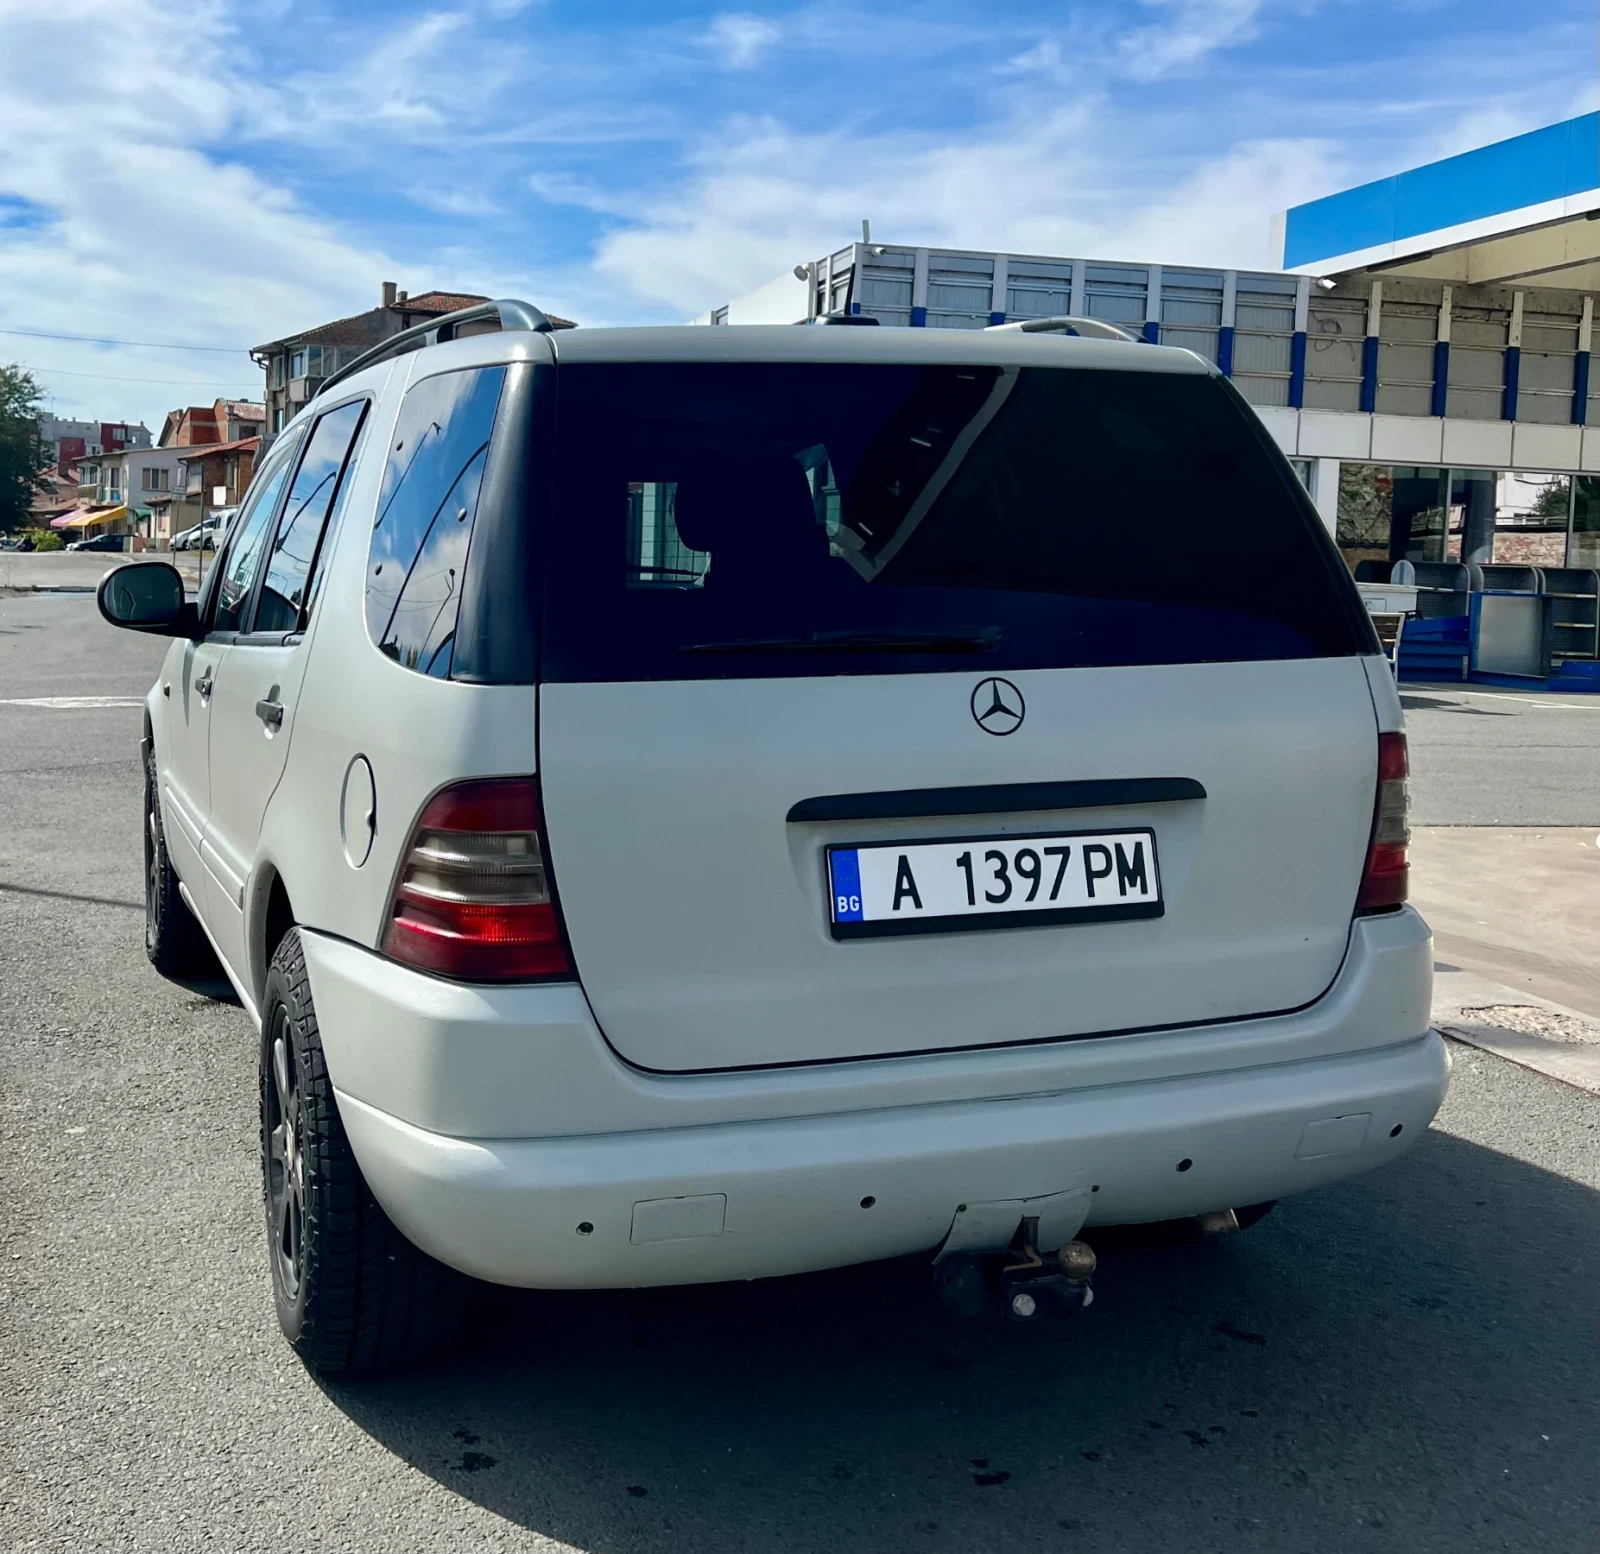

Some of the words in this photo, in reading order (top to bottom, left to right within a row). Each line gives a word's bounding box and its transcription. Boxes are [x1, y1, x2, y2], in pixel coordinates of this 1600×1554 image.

[892, 854, 923, 911] A
[956, 846, 1071, 905] 1397
[1082, 841, 1149, 898] PM
[837, 895, 860, 913] BG
